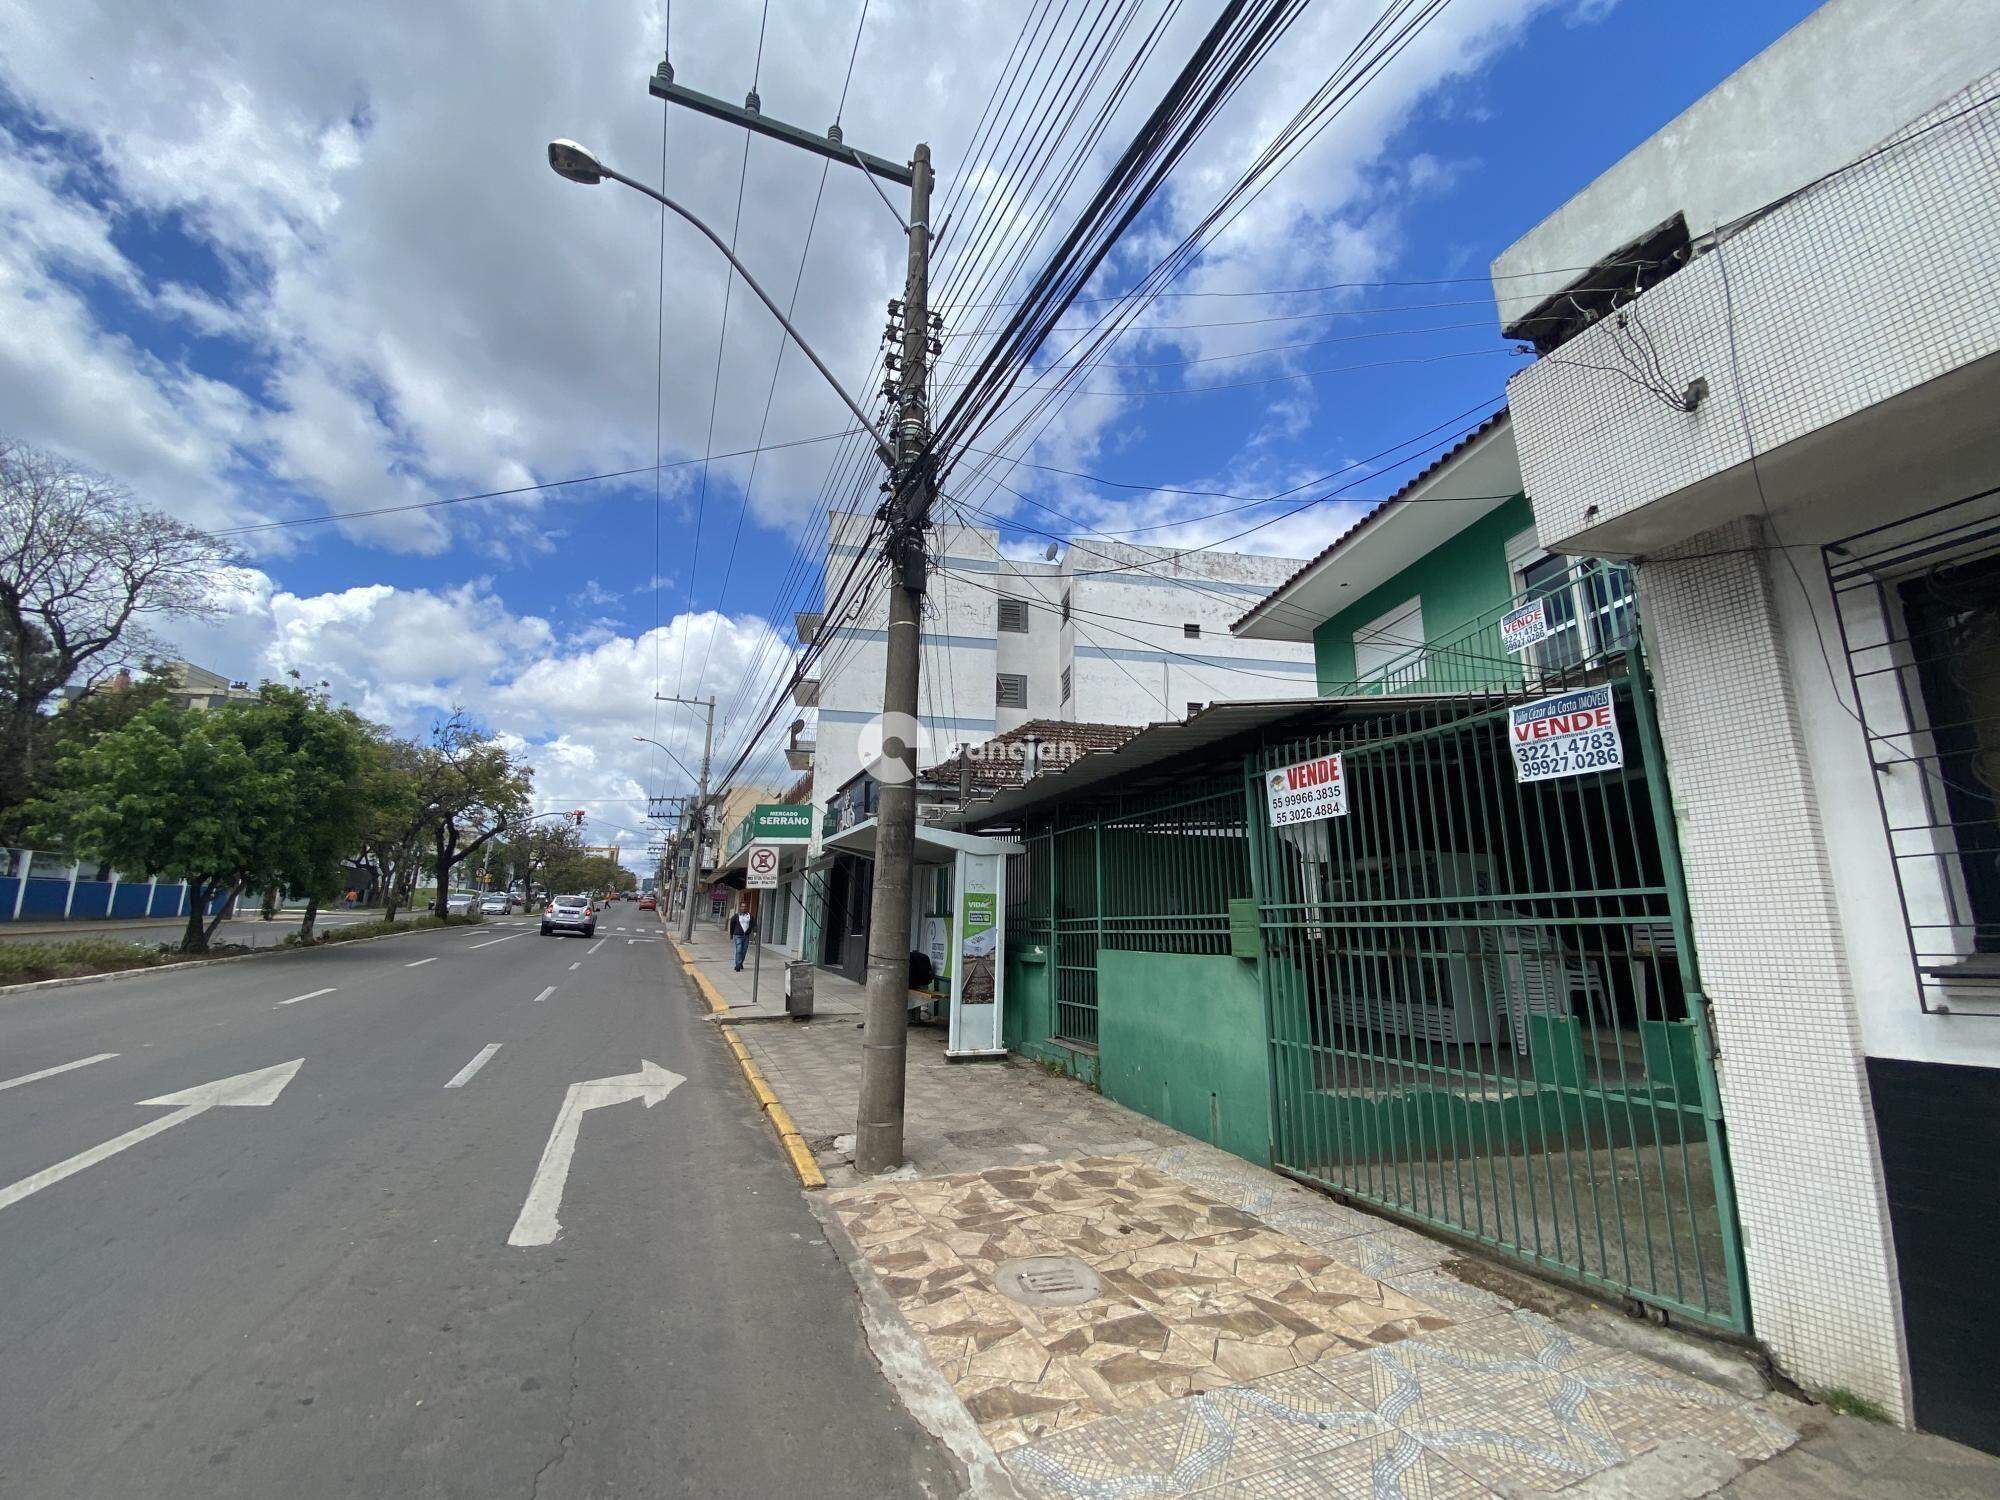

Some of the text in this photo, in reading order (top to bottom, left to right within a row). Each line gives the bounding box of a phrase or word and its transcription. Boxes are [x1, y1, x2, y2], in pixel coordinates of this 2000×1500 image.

[1504, 610, 1541, 634] VENDE
[1547, 702, 1556, 715] da
[1557, 697, 1577, 713] Costa
[1578, 691, 1608, 710] IMÓVEIS
[1515, 707, 1610, 741] VENDE
[1517, 732, 1616, 763] 3221.4783
[1286, 758, 1340, 791] VENDE
[1522, 748, 1619, 777] 99927.0286
[1273, 785, 1341, 809] 55 99966.3835
[759, 816, 809, 826] SERRANO
[1276, 802, 1340, 823] 55 3026.4884
